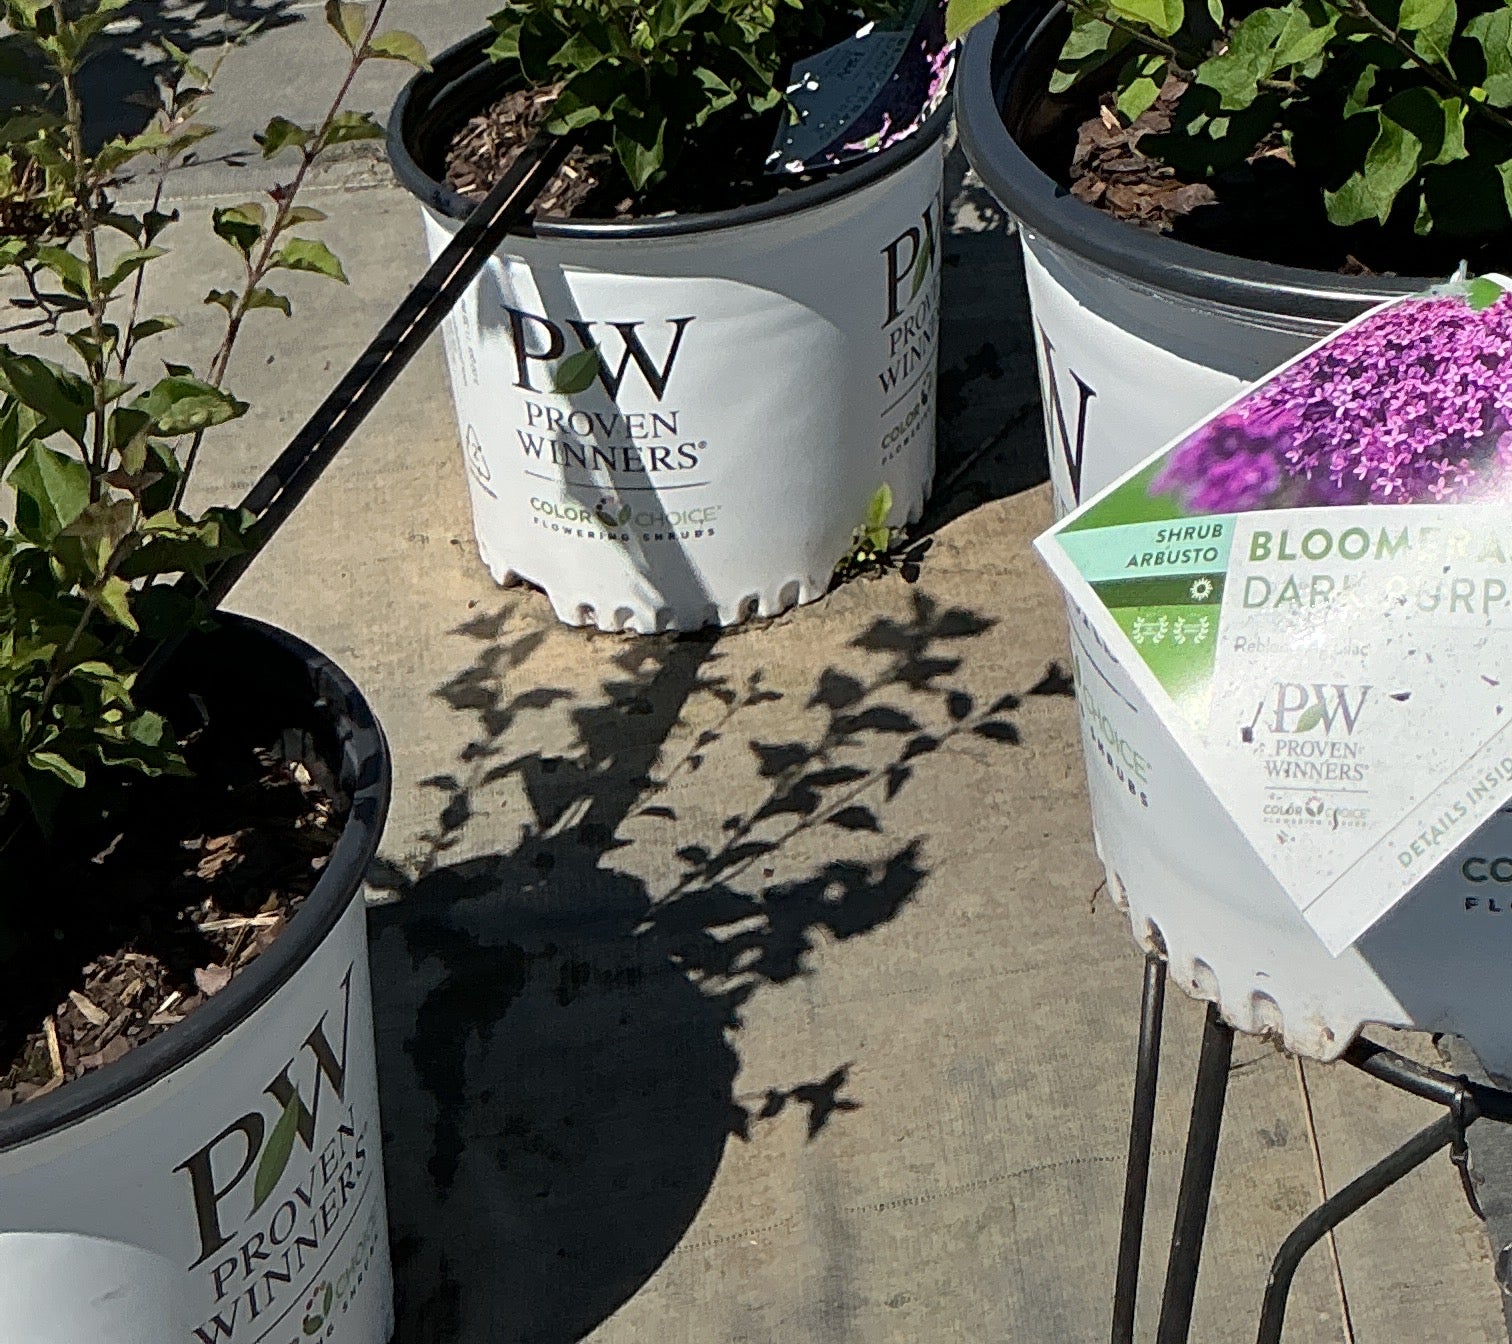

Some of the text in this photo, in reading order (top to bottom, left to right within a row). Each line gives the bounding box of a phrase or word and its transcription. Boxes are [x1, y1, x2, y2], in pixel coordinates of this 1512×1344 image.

[502, 305, 697, 403] PW
[524, 400, 681, 440] PROVEN
[530, 496, 594, 524] COLOR
[533, 516, 630, 542] FLOWERING
[643, 526, 716, 542] SHRUBS
[1155, 523, 1223, 544] SHRUB
[1125, 547, 1219, 569] ARBUSTO
[1270, 681, 1374, 736] PW
[1275, 739, 1359, 760] PROVEN
[1397, 802, 1467, 868] DETAILS
[172, 961, 356, 1272] PW
[210, 1102, 355, 1305] PROVEN
